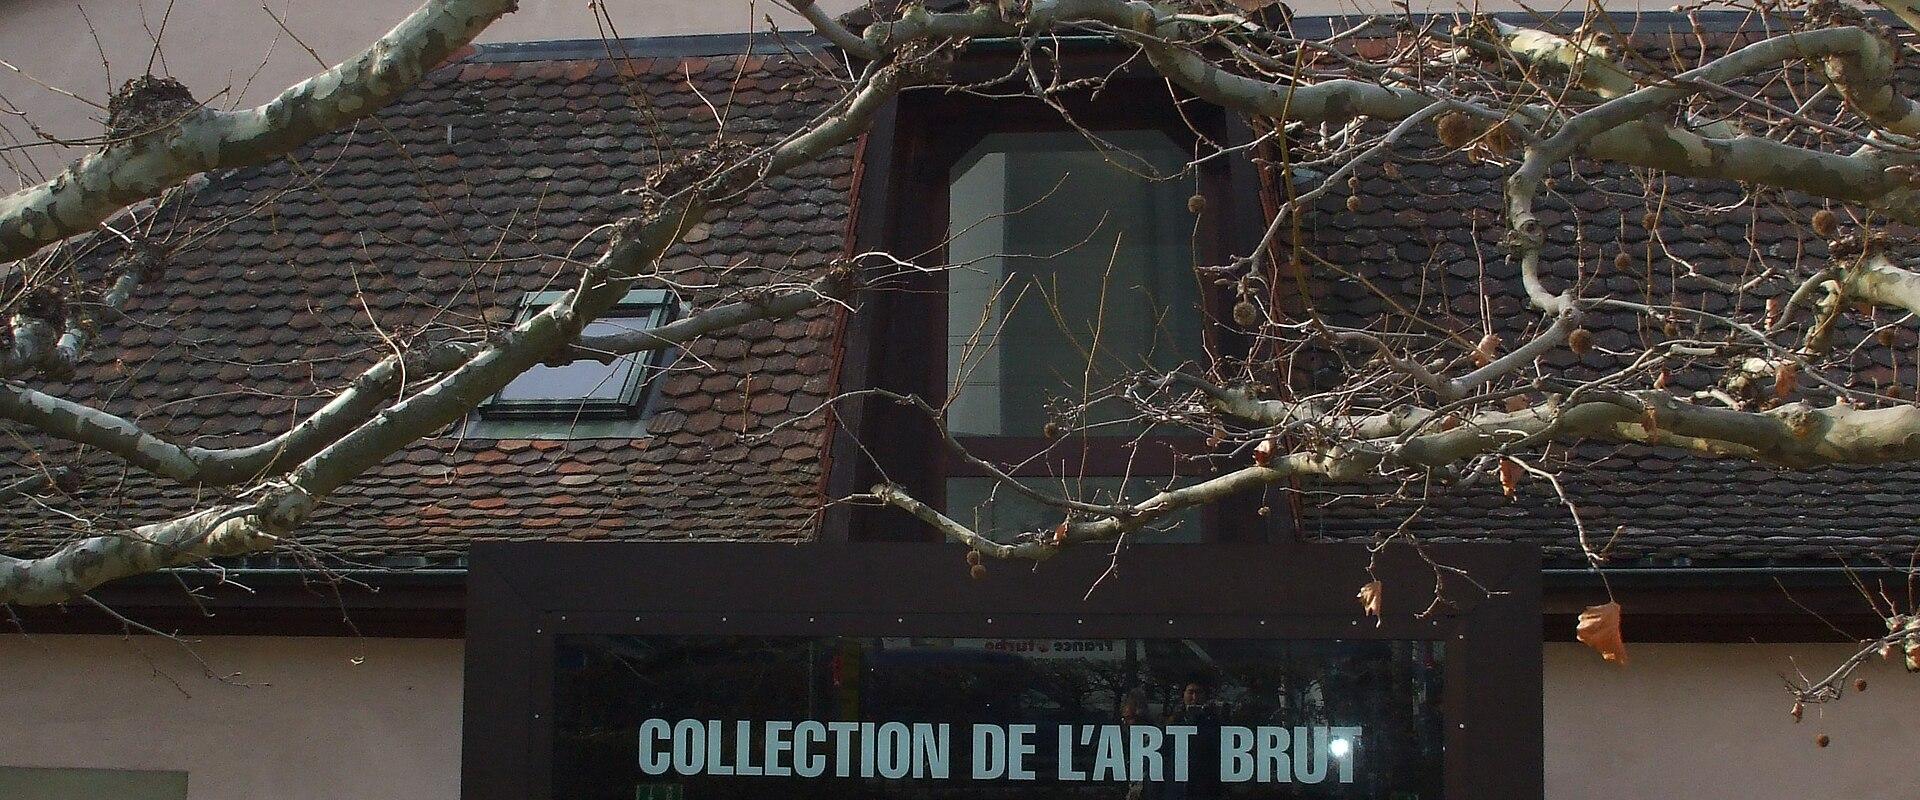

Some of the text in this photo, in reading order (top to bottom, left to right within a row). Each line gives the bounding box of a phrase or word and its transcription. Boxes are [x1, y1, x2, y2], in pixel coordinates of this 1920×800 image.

[639, 718, 1362, 784] COLLECTION DE L'ART BRUT
